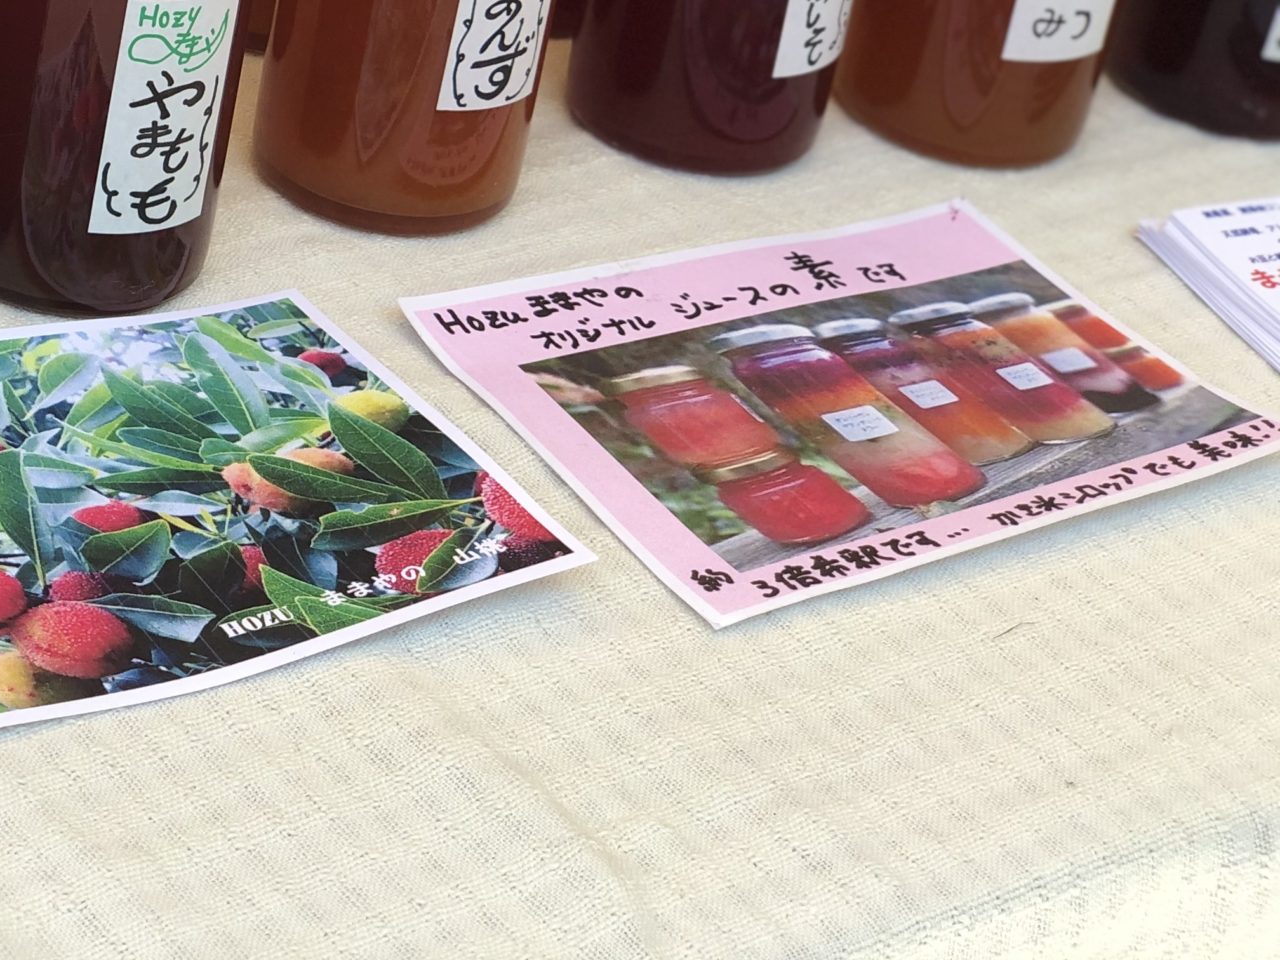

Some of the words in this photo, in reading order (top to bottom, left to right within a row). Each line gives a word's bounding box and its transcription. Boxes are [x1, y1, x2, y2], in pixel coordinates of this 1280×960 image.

[128, 71, 207, 225] やまもも
[219, 605, 296, 638] HOZU
